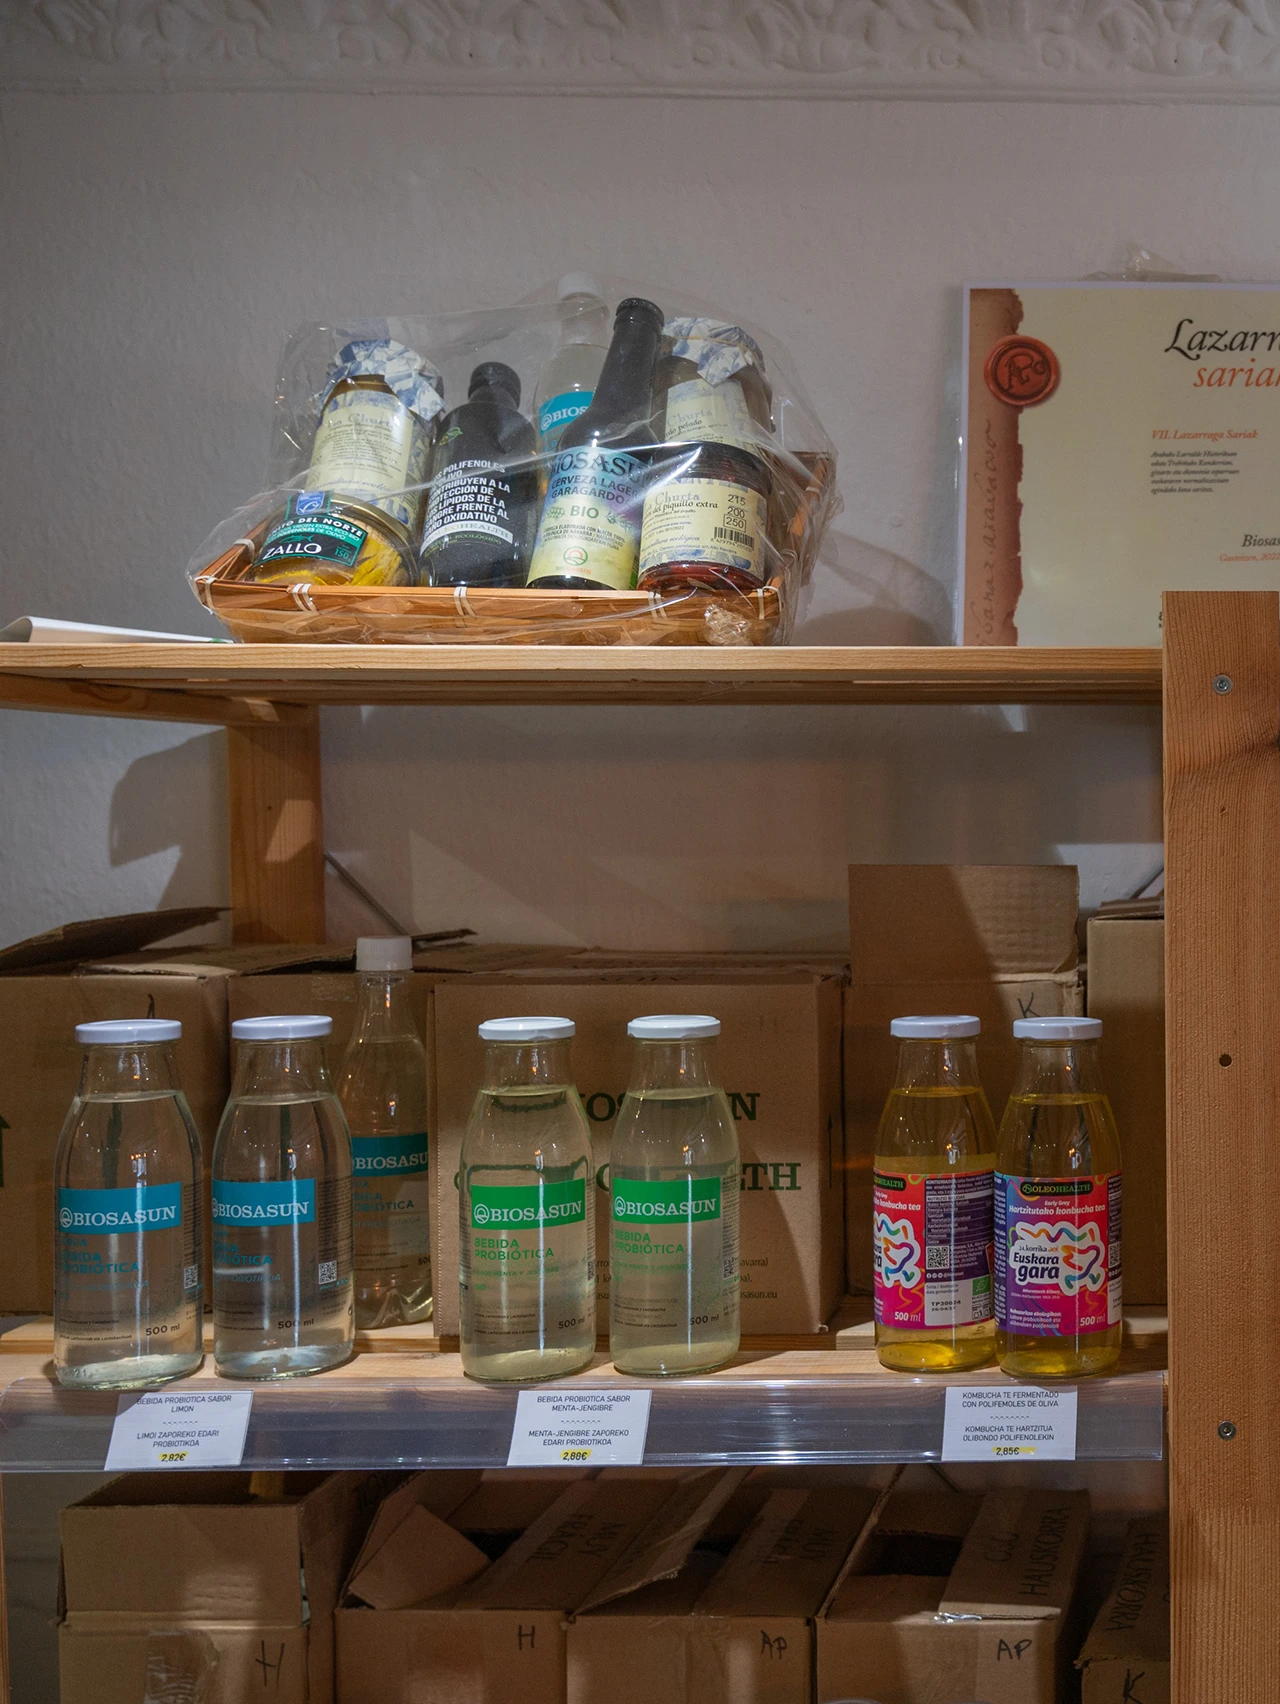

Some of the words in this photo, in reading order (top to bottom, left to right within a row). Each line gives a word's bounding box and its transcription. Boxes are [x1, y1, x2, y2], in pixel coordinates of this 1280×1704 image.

[1173, 430, 1224, 442] Lazarraga
[1226, 429, 1259, 440] Sariak
[443, 460, 506, 476] POLIFENOLES
[498, 481, 511, 494] LA
[551, 474, 598, 490] CERVEZA
[695, 501, 718, 509] extra
[727, 493, 746, 506] 215
[456, 502, 496, 514] FRENTE
[569, 505, 600, 519] BIO
[727, 506, 745, 519] 200
[443, 511, 498, 524] OXIDATIVO
[726, 516, 744, 529] 250
[324, 518, 363, 537] NORTE
[262, 543, 322, 560] ZALLO
[355, 1152, 428, 1170] BIOSASU
[1032, 1184, 1091, 1193] OLEOHEALTH
[218, 1201, 309, 1218] BIOSASUN
[490, 1200, 582, 1222] BIOSASUN
[626, 1198, 716, 1216] BIOSASUN
[880, 1201, 907, 1210] konbucha
[908, 1203, 921, 1211] tea
[1008, 1204, 1055, 1215] Hartzitutako
[1055, 1206, 1094, 1215] konbucha
[73, 1206, 176, 1226] BIOSASUN
[614, 1229, 651, 1243] BEBIDA
[474, 1237, 520, 1249] BEBIDA
[615, 1242, 685, 1255] PROBIÓTICA
[474, 1247, 554, 1260] PROBIÓTICA
[1013, 1252, 1060, 1265] Euskara
[1017, 1265, 1060, 1282] gara
[894, 1311, 909, 1321] 500
[1080, 1315, 1095, 1326] 500
[145, 1325, 168, 1336] 500
[170, 1323, 180, 1332] ml
[136, 1397, 163, 1405] BEBIDA
[164, 1396, 206, 1404] PROBIOTICA
[171, 1405, 194, 1413] LIMON
[552, 1404, 613, 1412] MENTA-JENGIBRE
[137, 1432, 157, 1440] LIMOI
[158, 1431, 196, 1439] ZAPOREKO
[965, 1425, 1004, 1433] KOMBUCHA
[153, 1440, 200, 1448] PROBIOTIKOA
[963, 1434, 998, 1442] OLIBONDO
[161, 1453, 186, 1462] 2,82€
[562, 1452, 588, 1461] 2,88€
[996, 1447, 1020, 1456] 2,85€
[518, 1624, 536, 1651] H
[997, 1638, 1033, 1661] AP
